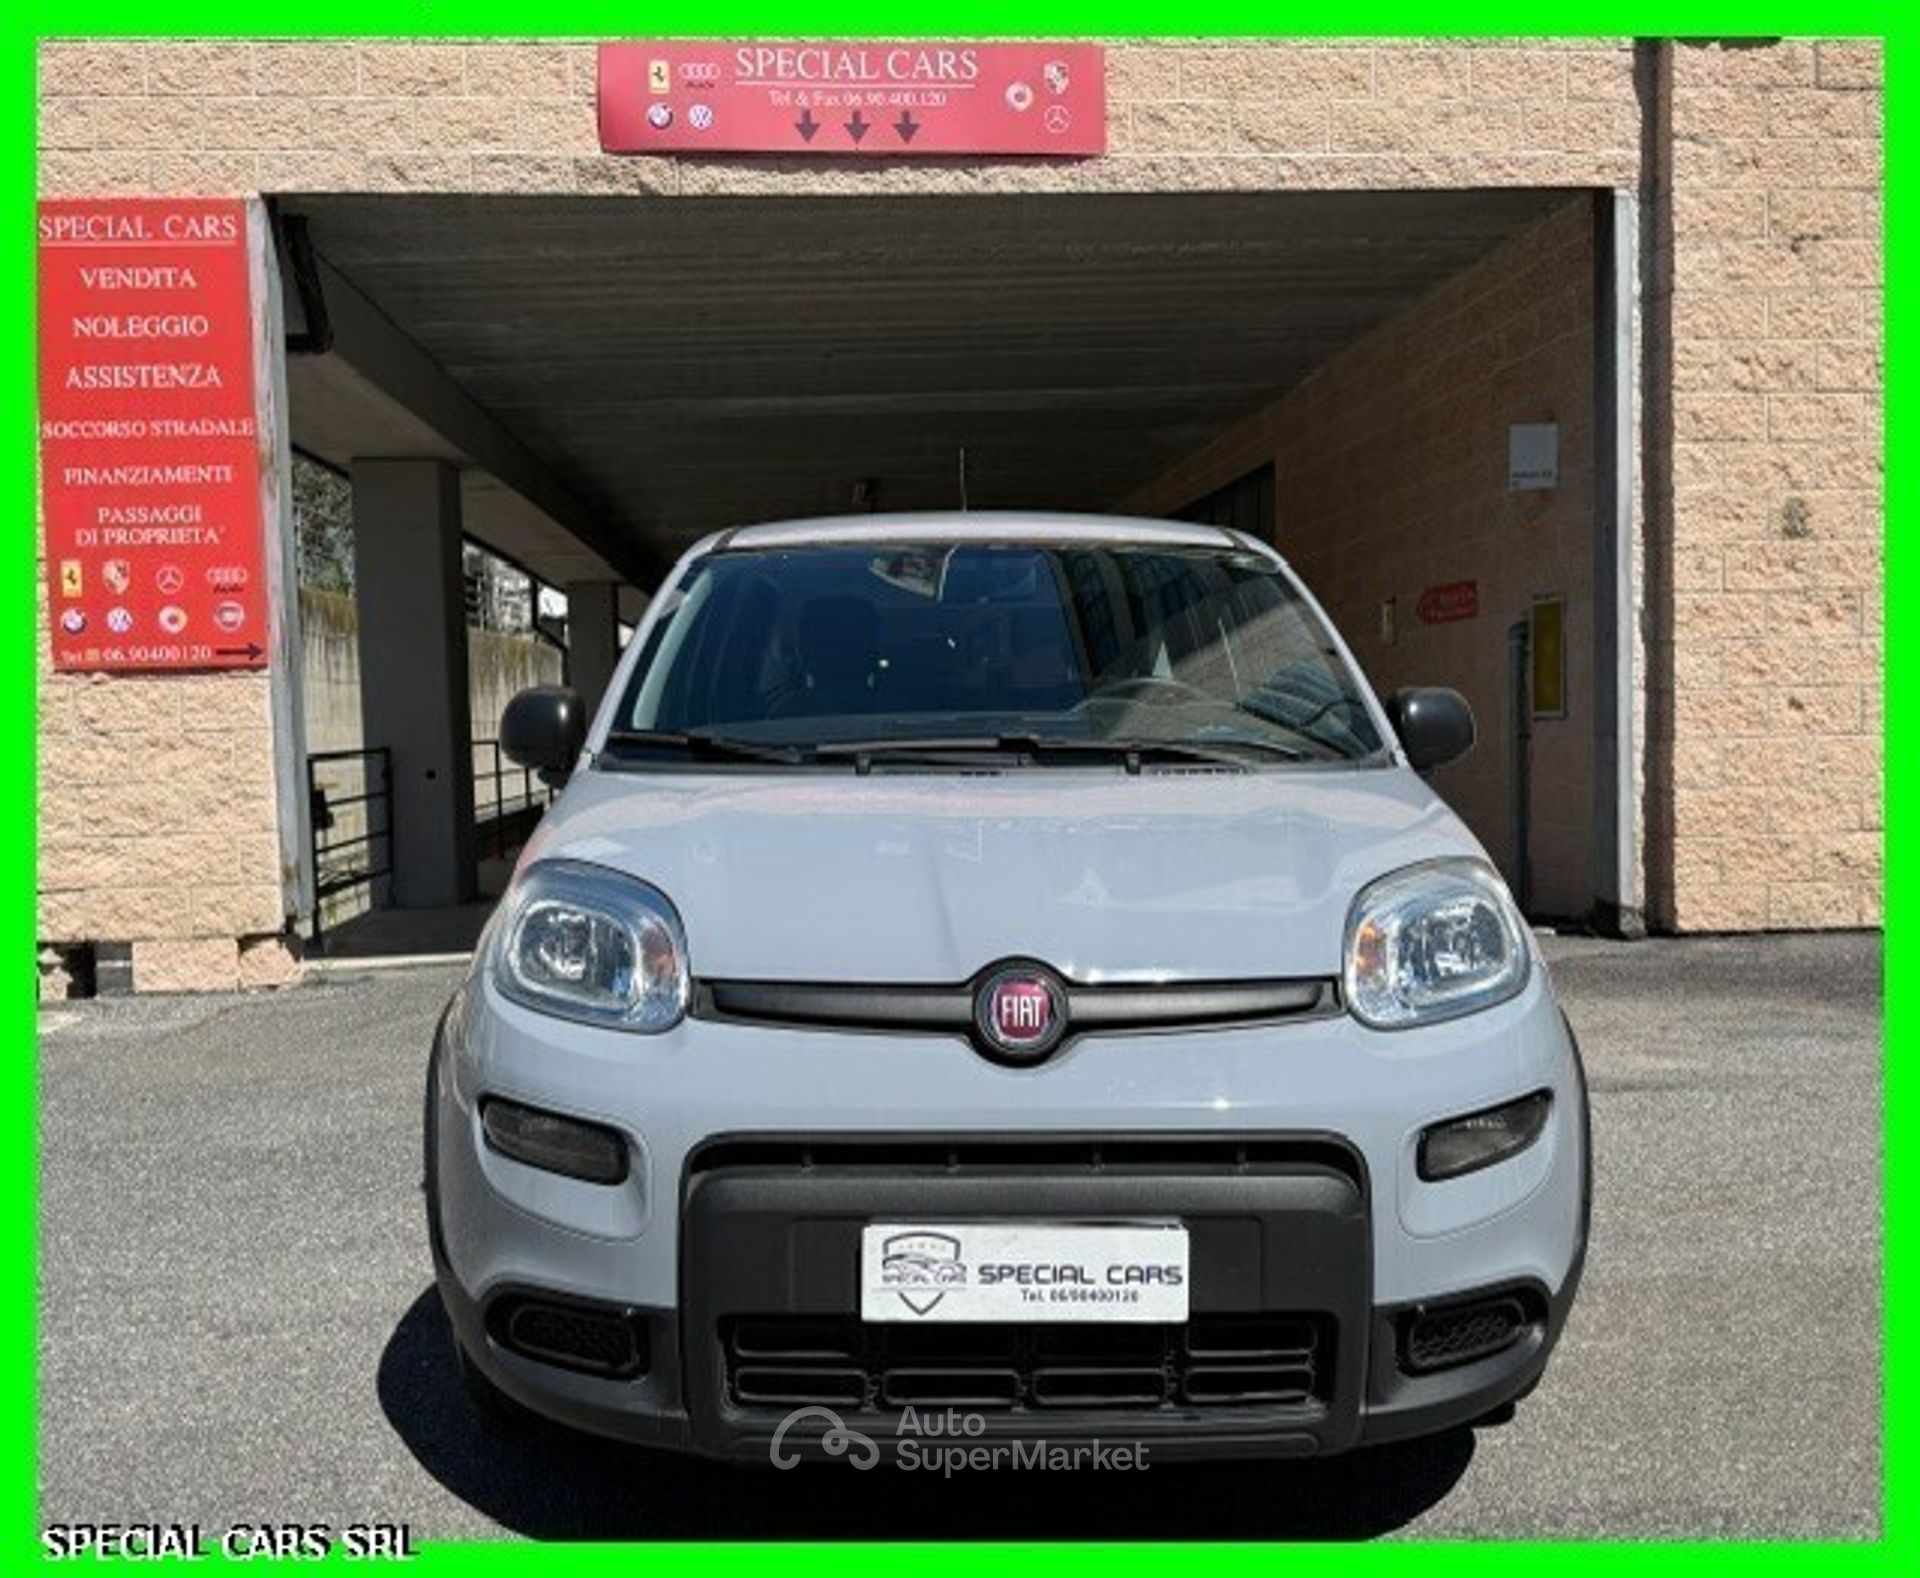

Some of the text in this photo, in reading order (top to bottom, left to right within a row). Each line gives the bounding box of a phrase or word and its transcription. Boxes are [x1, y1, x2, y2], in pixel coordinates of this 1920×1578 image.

[735, 49, 978, 80] SPECIAL CARS
[769, 91, 790, 106] Tel
[39, 216, 236, 239] SPECIAL CARS
[80, 268, 196, 289] VENDITA
[73, 316, 208, 338] NOLEGGIO
[66, 366, 222, 389] ASSISTENZA
[42, 418, 254, 439] SOCCORSO STRADALE
[64, 466, 232, 485] FINANZIAMENTI
[98, 507, 202, 524] PASSAGGI
[76, 530, 98, 546] DI
[1001, 995, 1042, 1028] FIAT
[979, 1264, 1184, 1285] SPECIAL CARS
